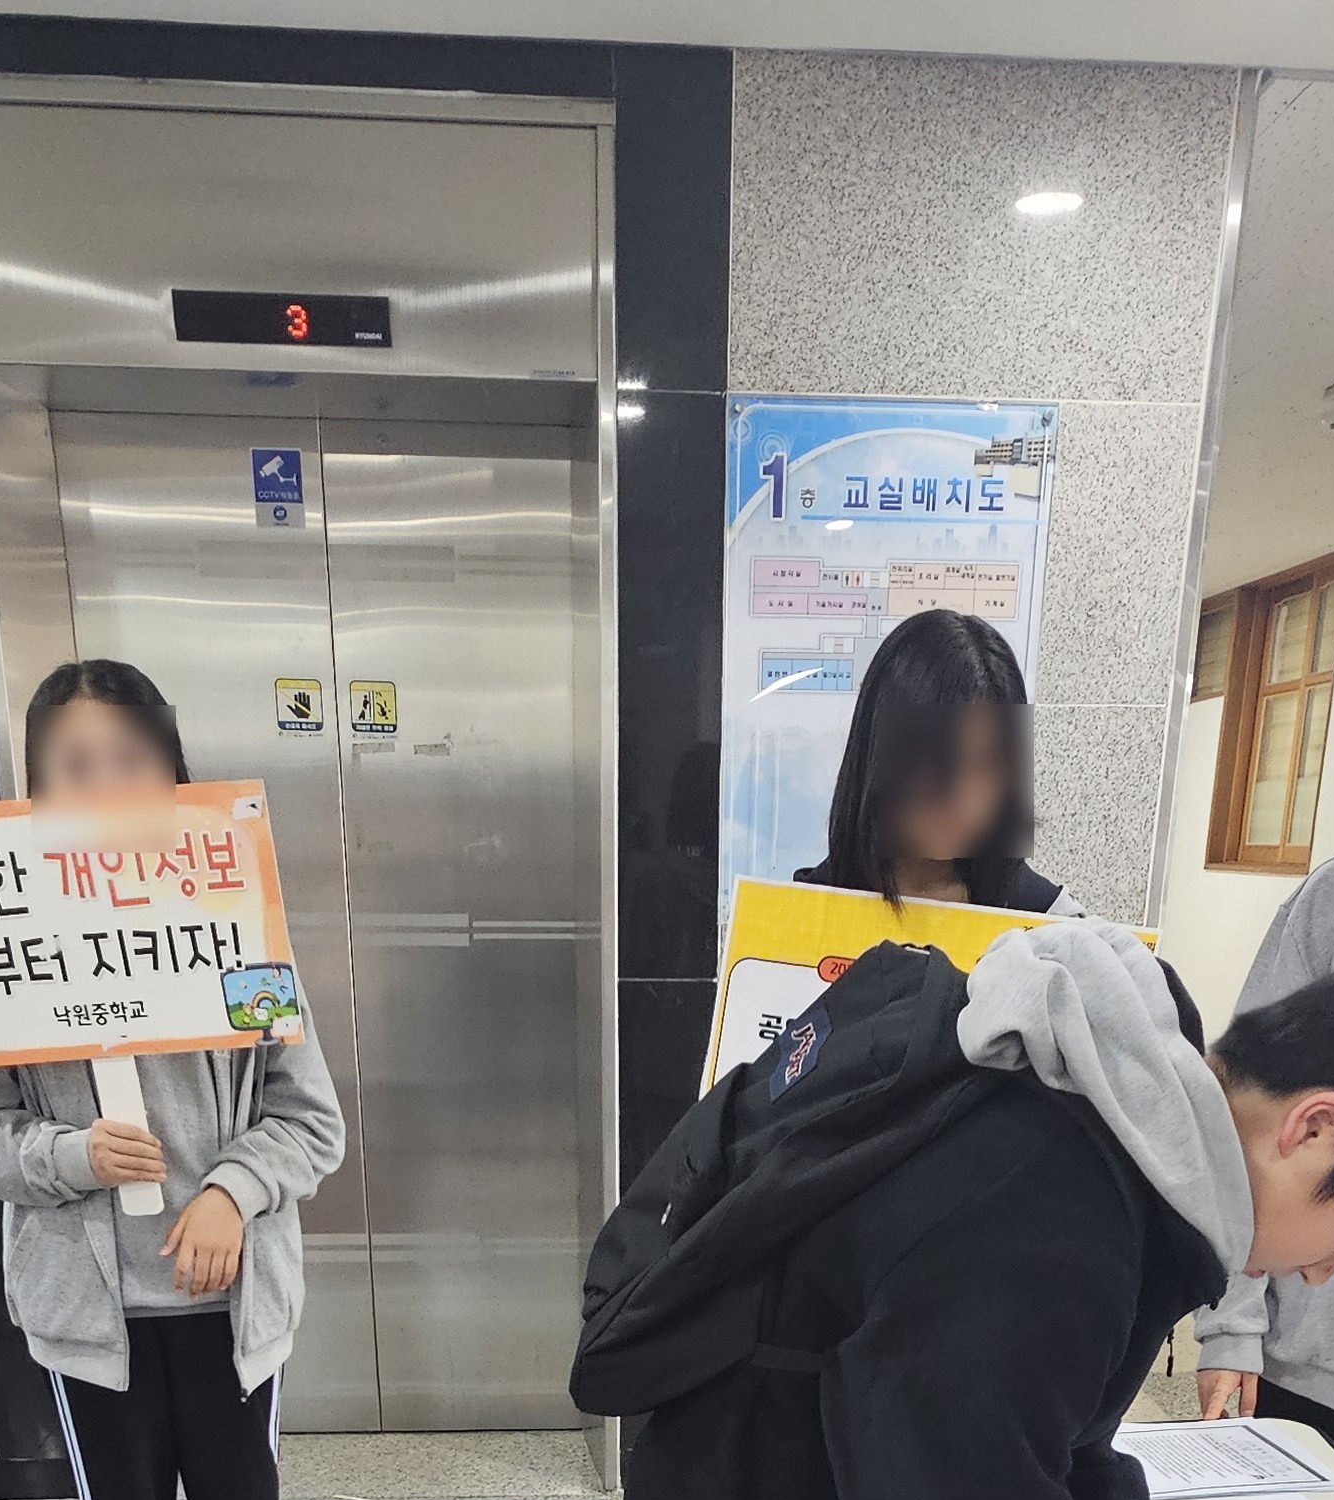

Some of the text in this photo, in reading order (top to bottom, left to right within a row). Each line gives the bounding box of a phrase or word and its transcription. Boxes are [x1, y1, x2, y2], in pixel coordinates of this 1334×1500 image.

[286, 303, 310, 340] 3
[843, 475, 1005, 513] 교실배치도
[82, 921, 245, 979] 지키자!
[53, 1000, 149, 1029] 낙원중학교
